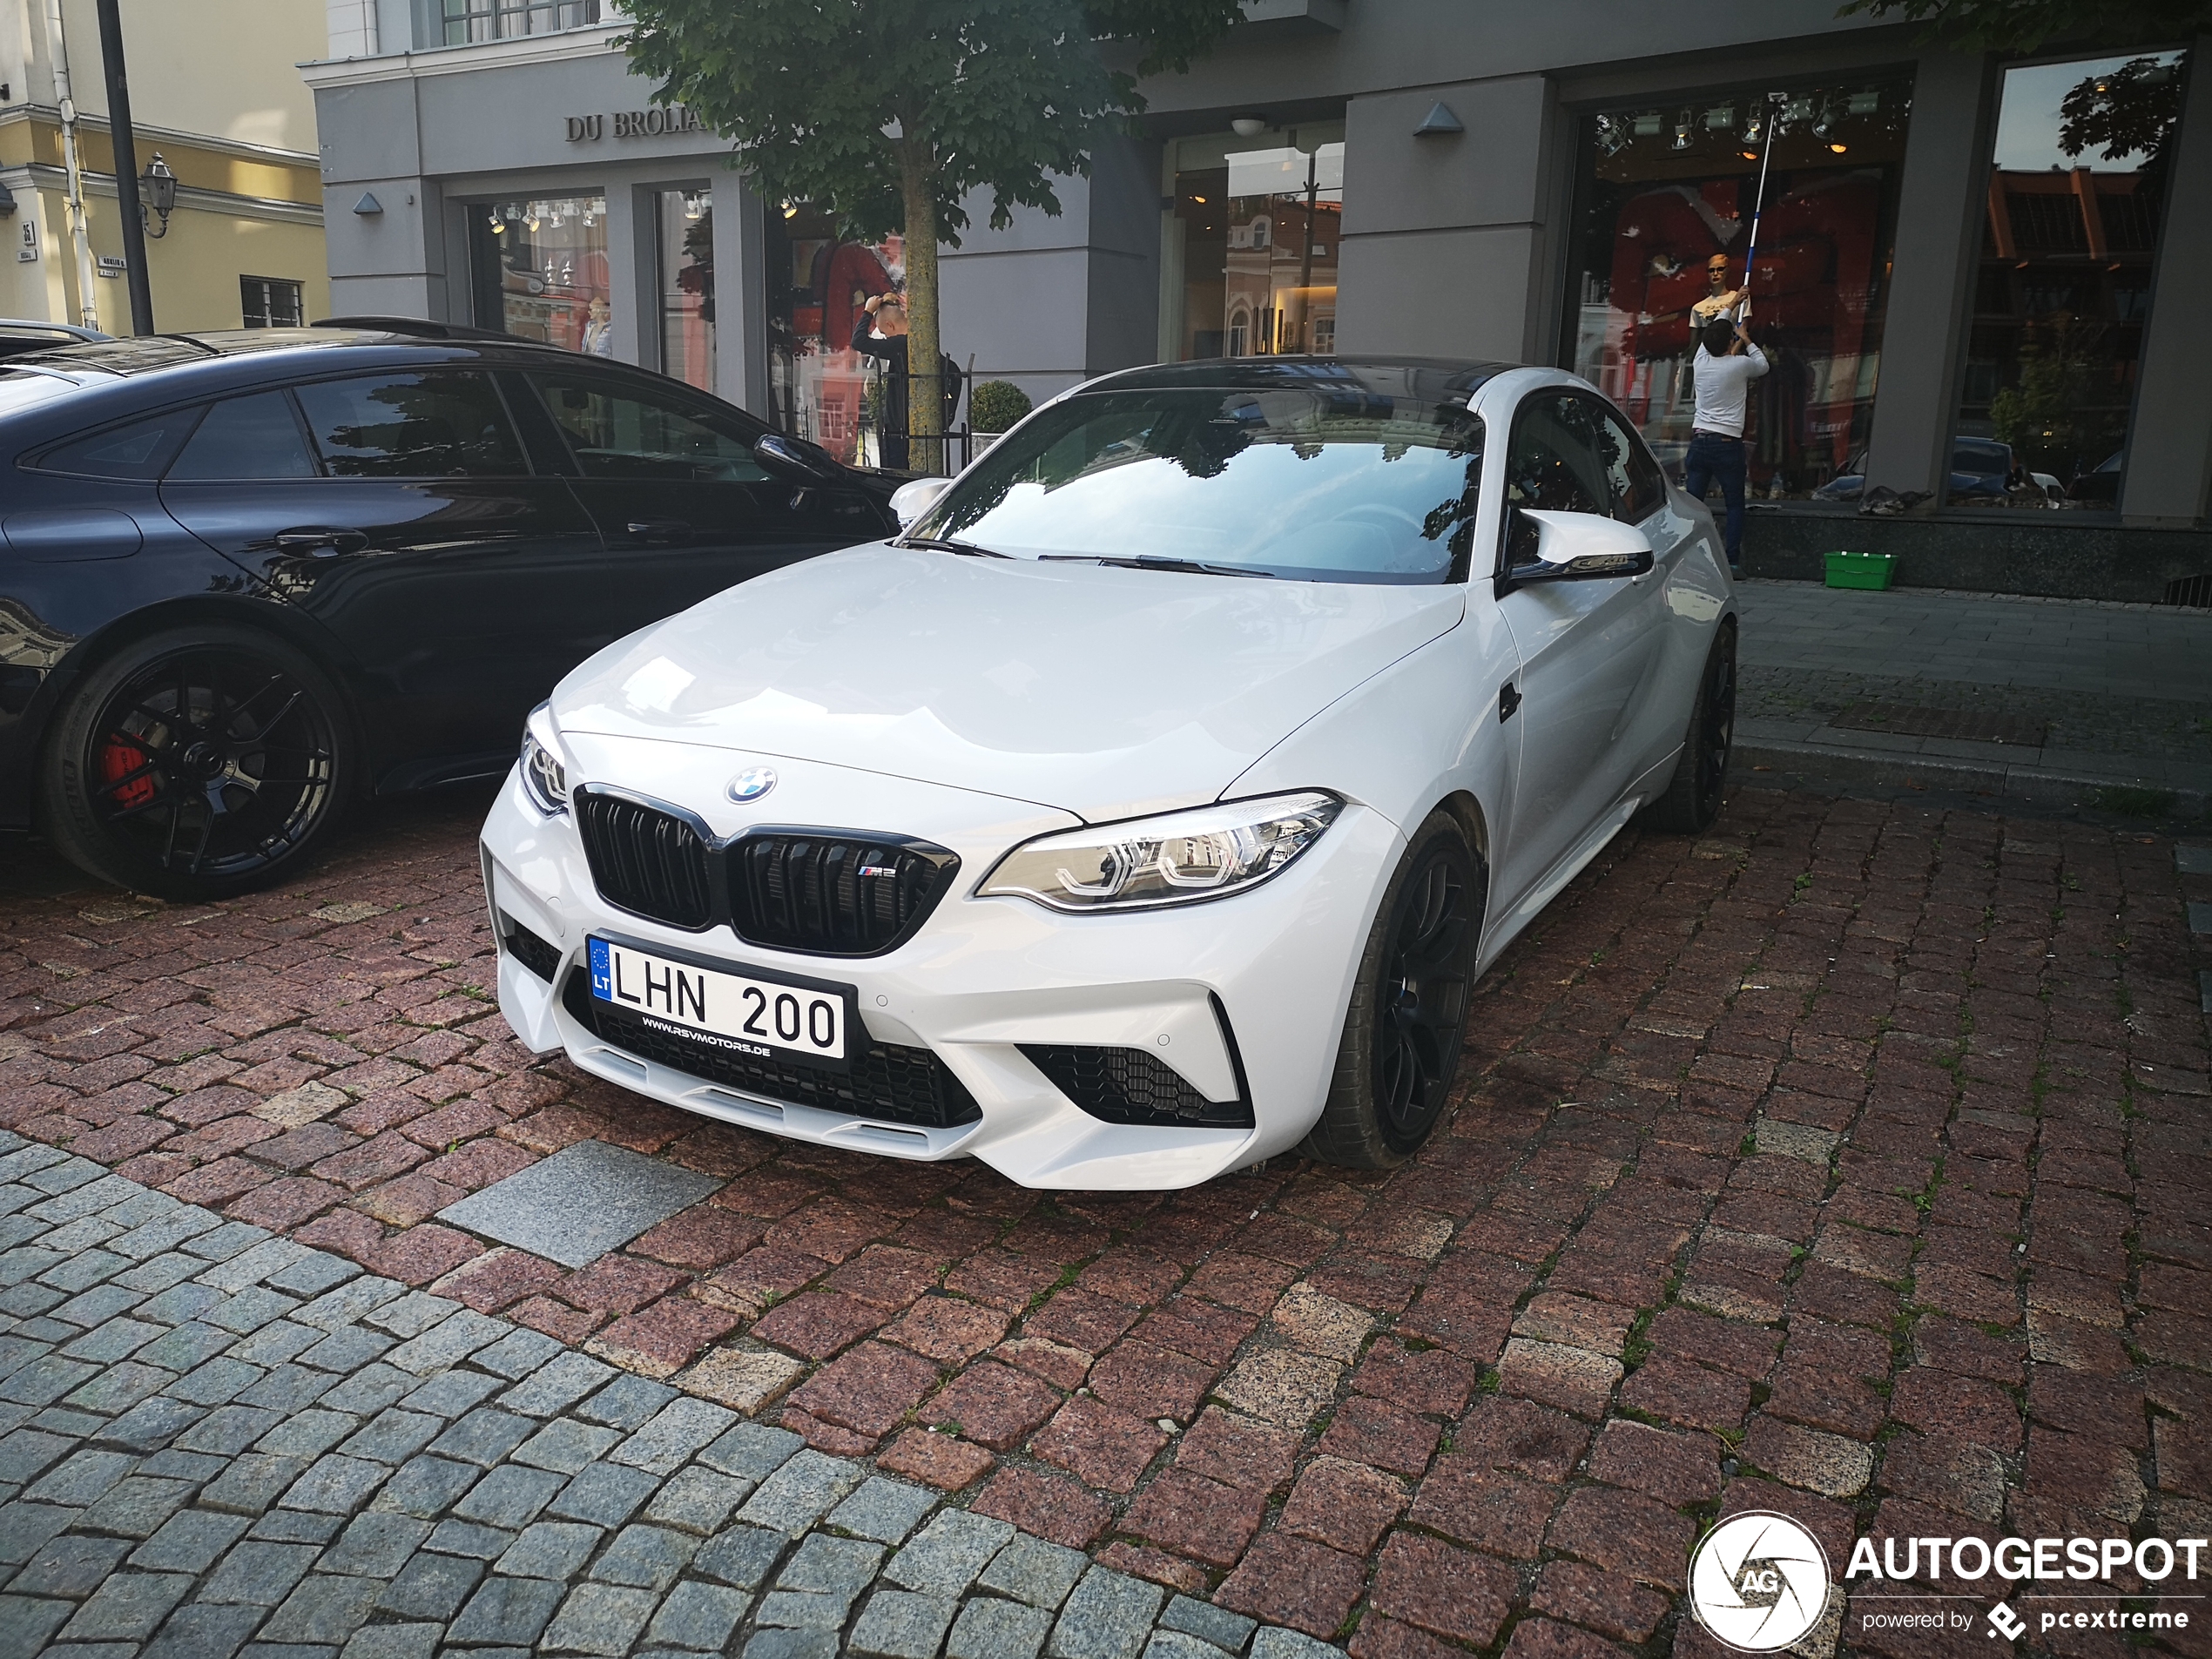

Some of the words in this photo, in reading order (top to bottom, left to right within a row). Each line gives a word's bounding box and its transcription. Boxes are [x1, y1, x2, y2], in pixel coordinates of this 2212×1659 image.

[563, 115, 604, 142] DU
[860, 866, 896, 878] M2
[593, 974, 610, 992] LT
[614, 952, 706, 1023] LHN
[742, 987, 835, 1049] 200
[642, 1016, 772, 1057] WWW.RSVMOTORS.DE
